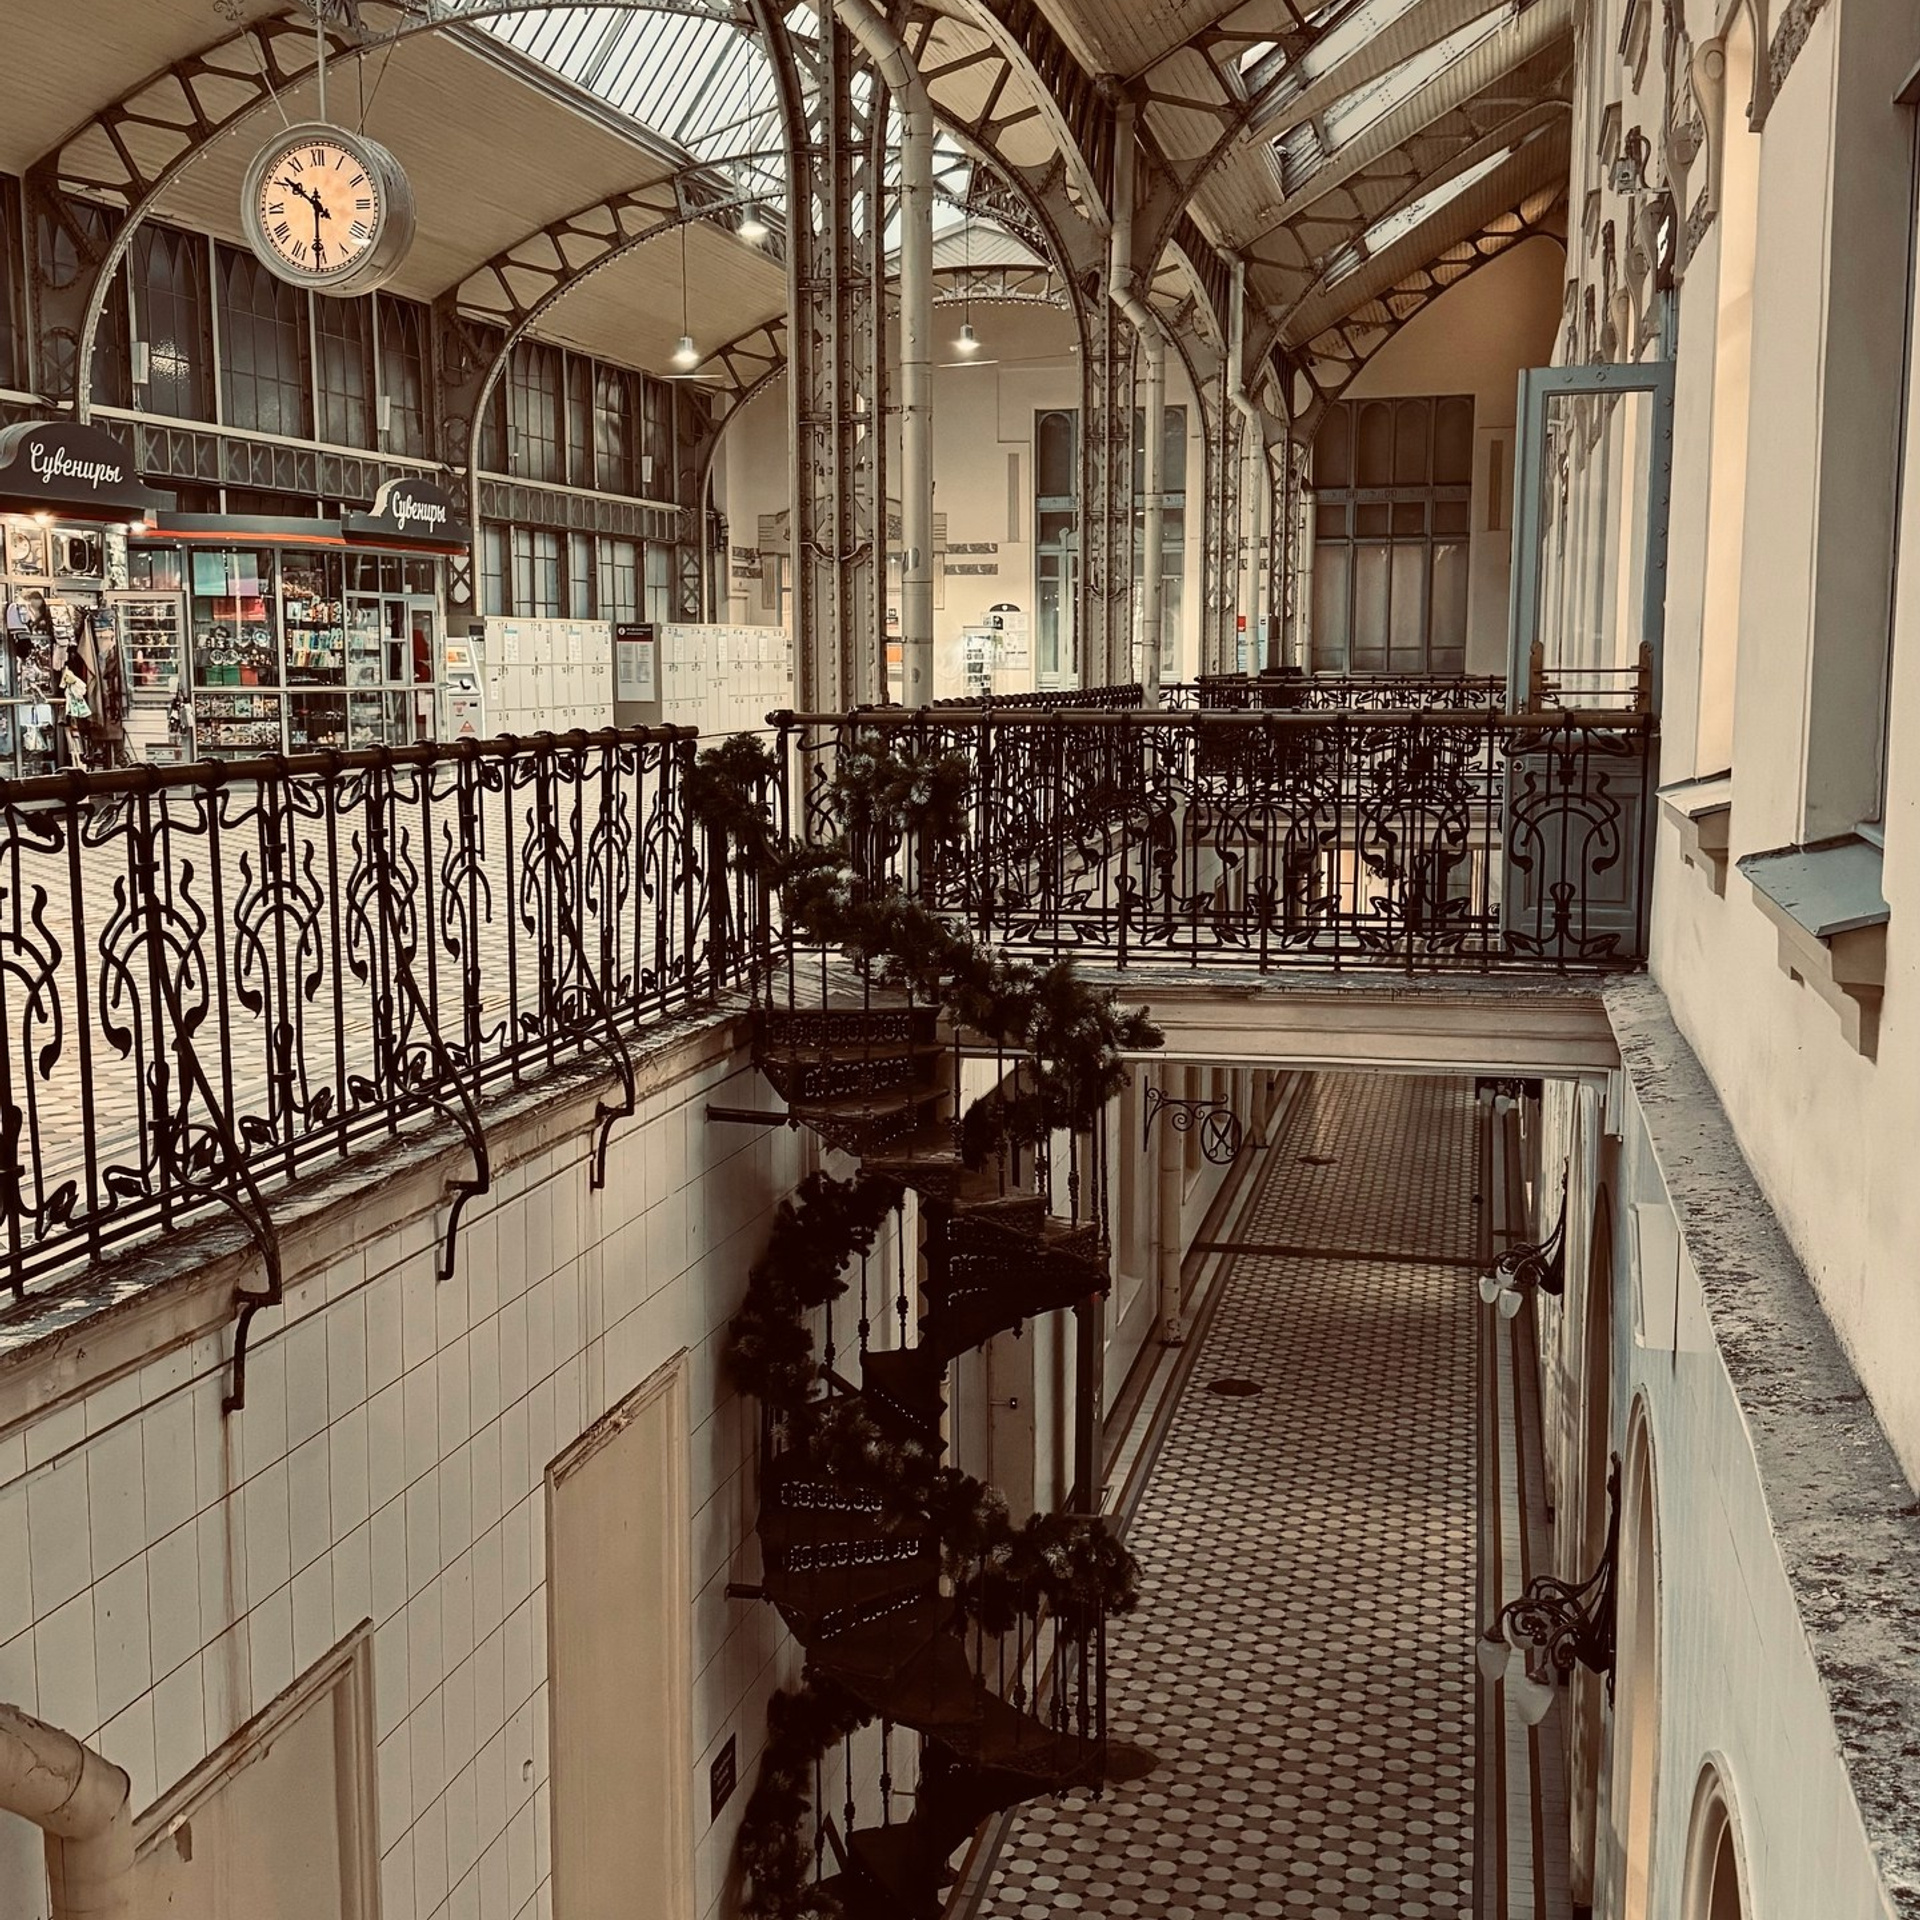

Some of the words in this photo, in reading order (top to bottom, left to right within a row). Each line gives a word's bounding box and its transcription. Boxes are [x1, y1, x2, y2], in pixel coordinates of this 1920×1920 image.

[287, 156, 304, 177] XI
[310, 149, 325, 167] XII
[273, 176, 289, 192] X
[350, 174, 364, 188] II
[268, 202, 284, 214] IX
[356, 199, 371, 210] III
[273, 221, 290, 244] VIII
[291, 240, 307, 260] VII
[30, 441, 124, 490] Сувениры
[392, 490, 447, 533] Сувениры
